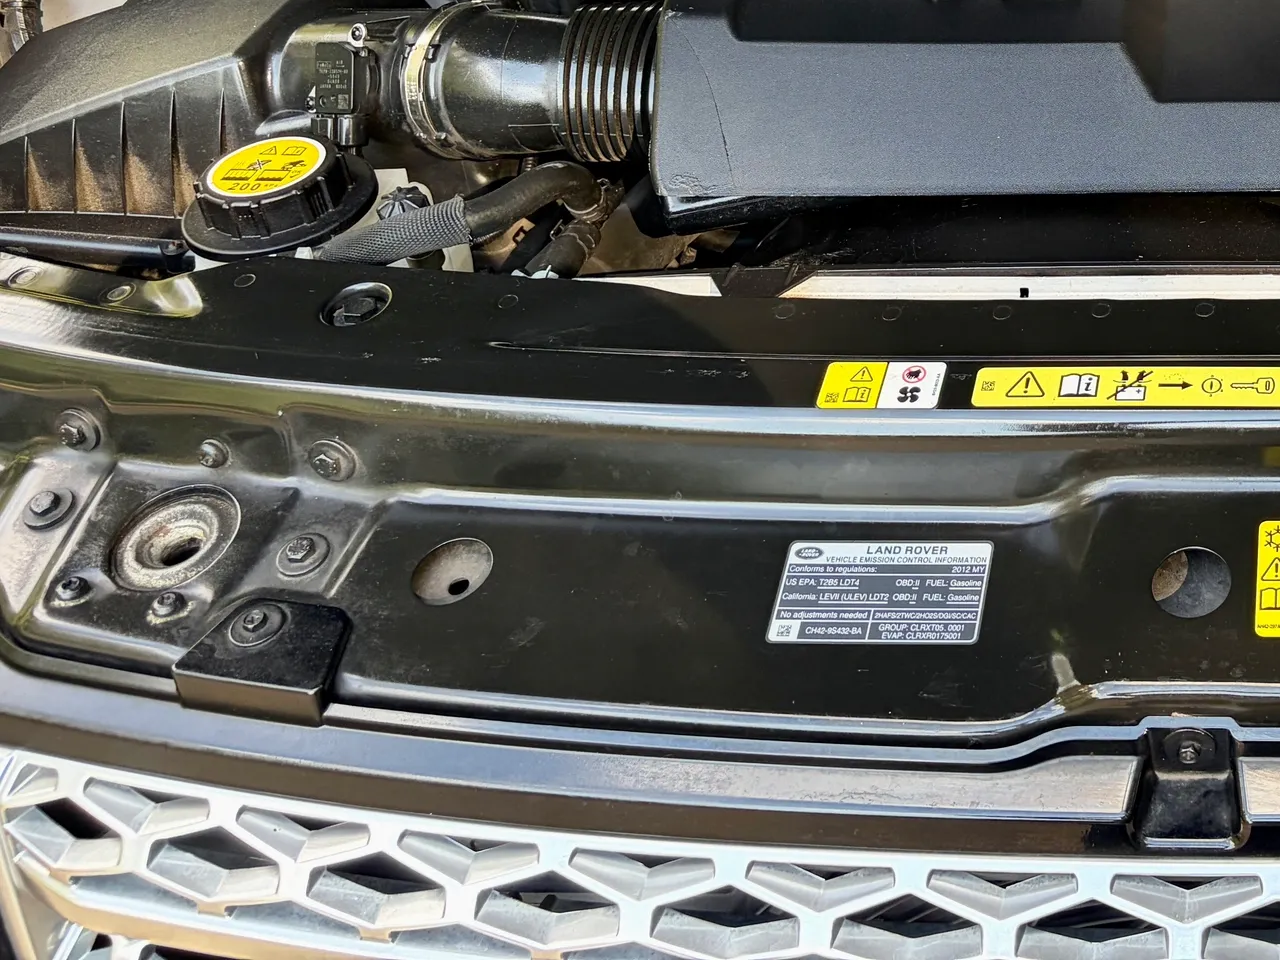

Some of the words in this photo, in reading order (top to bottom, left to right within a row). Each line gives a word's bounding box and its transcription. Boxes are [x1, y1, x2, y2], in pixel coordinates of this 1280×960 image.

[228, 183, 261, 191] 200
[866, 546, 902, 555] LAND
[906, 546, 948, 555] ROVER
[789, 565, 825, 573] Conforms
[835, 565, 878, 574] regulations:
[786, 578, 797, 586] US
[798, 578, 817, 586] EPA:
[819, 578, 838, 586] T2B5
[839, 578, 860, 586] LDT4
[926, 579, 948, 587] FUEL:
[950, 579, 982, 587] Gasoline
[782, 593, 818, 601] California:
[819, 593, 840, 601] LEVII
[841, 593, 867, 602] (ULEV)
[868, 593, 889, 601] LDT2
[922, 593, 946, 602] FUEL:
[947, 593, 979, 602] Gasoline
[792, 611, 837, 620] adjustments
[838, 611, 868, 619] needed
